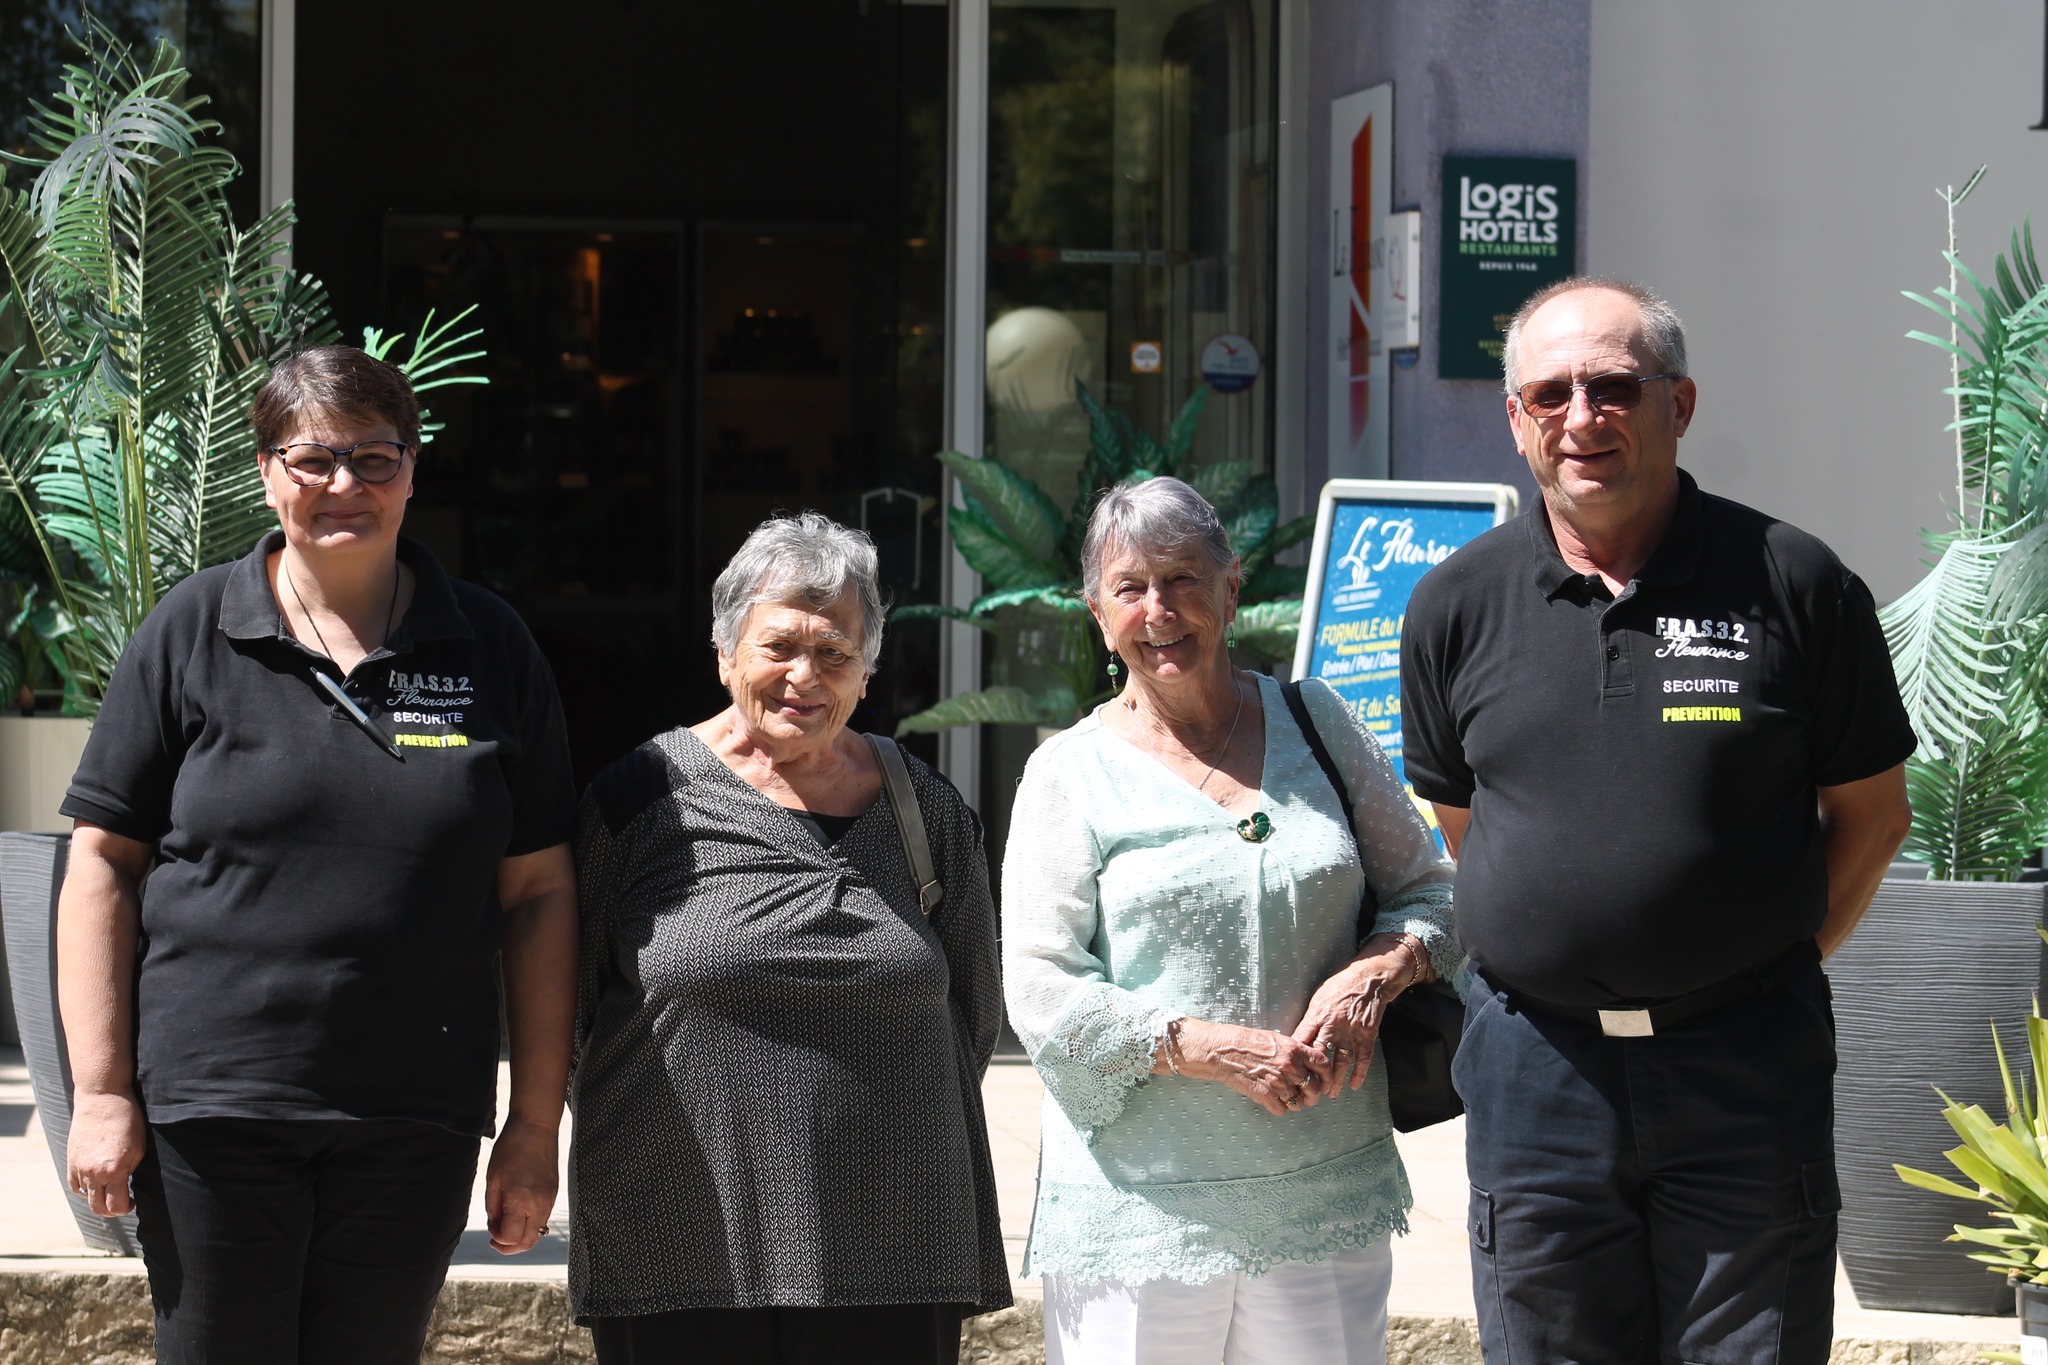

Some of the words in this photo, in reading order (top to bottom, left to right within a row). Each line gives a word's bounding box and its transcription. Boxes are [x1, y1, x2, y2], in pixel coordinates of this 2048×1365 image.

[1460, 220, 1559, 243] HOTELS
[1459, 243, 1558, 257] RESTAURANTS
[1479, 261, 1513, 271] DEPUIS
[1336, 516, 1379, 570] Le
[1320, 617, 1380, 647] FORMULE
[1379, 616, 1396, 638] du
[1654, 635, 1750, 661] Fleurance
[1379, 650, 1399, 668] Dess
[1662, 679, 1740, 694] SECURITE
[386, 688, 474, 708] Fleurance
[1366, 697, 1384, 719] du
[1662, 706, 1741, 722] PREVENTION
[393, 711, 463, 725] SECURITE
[394, 733, 469, 749] PREVENTION
